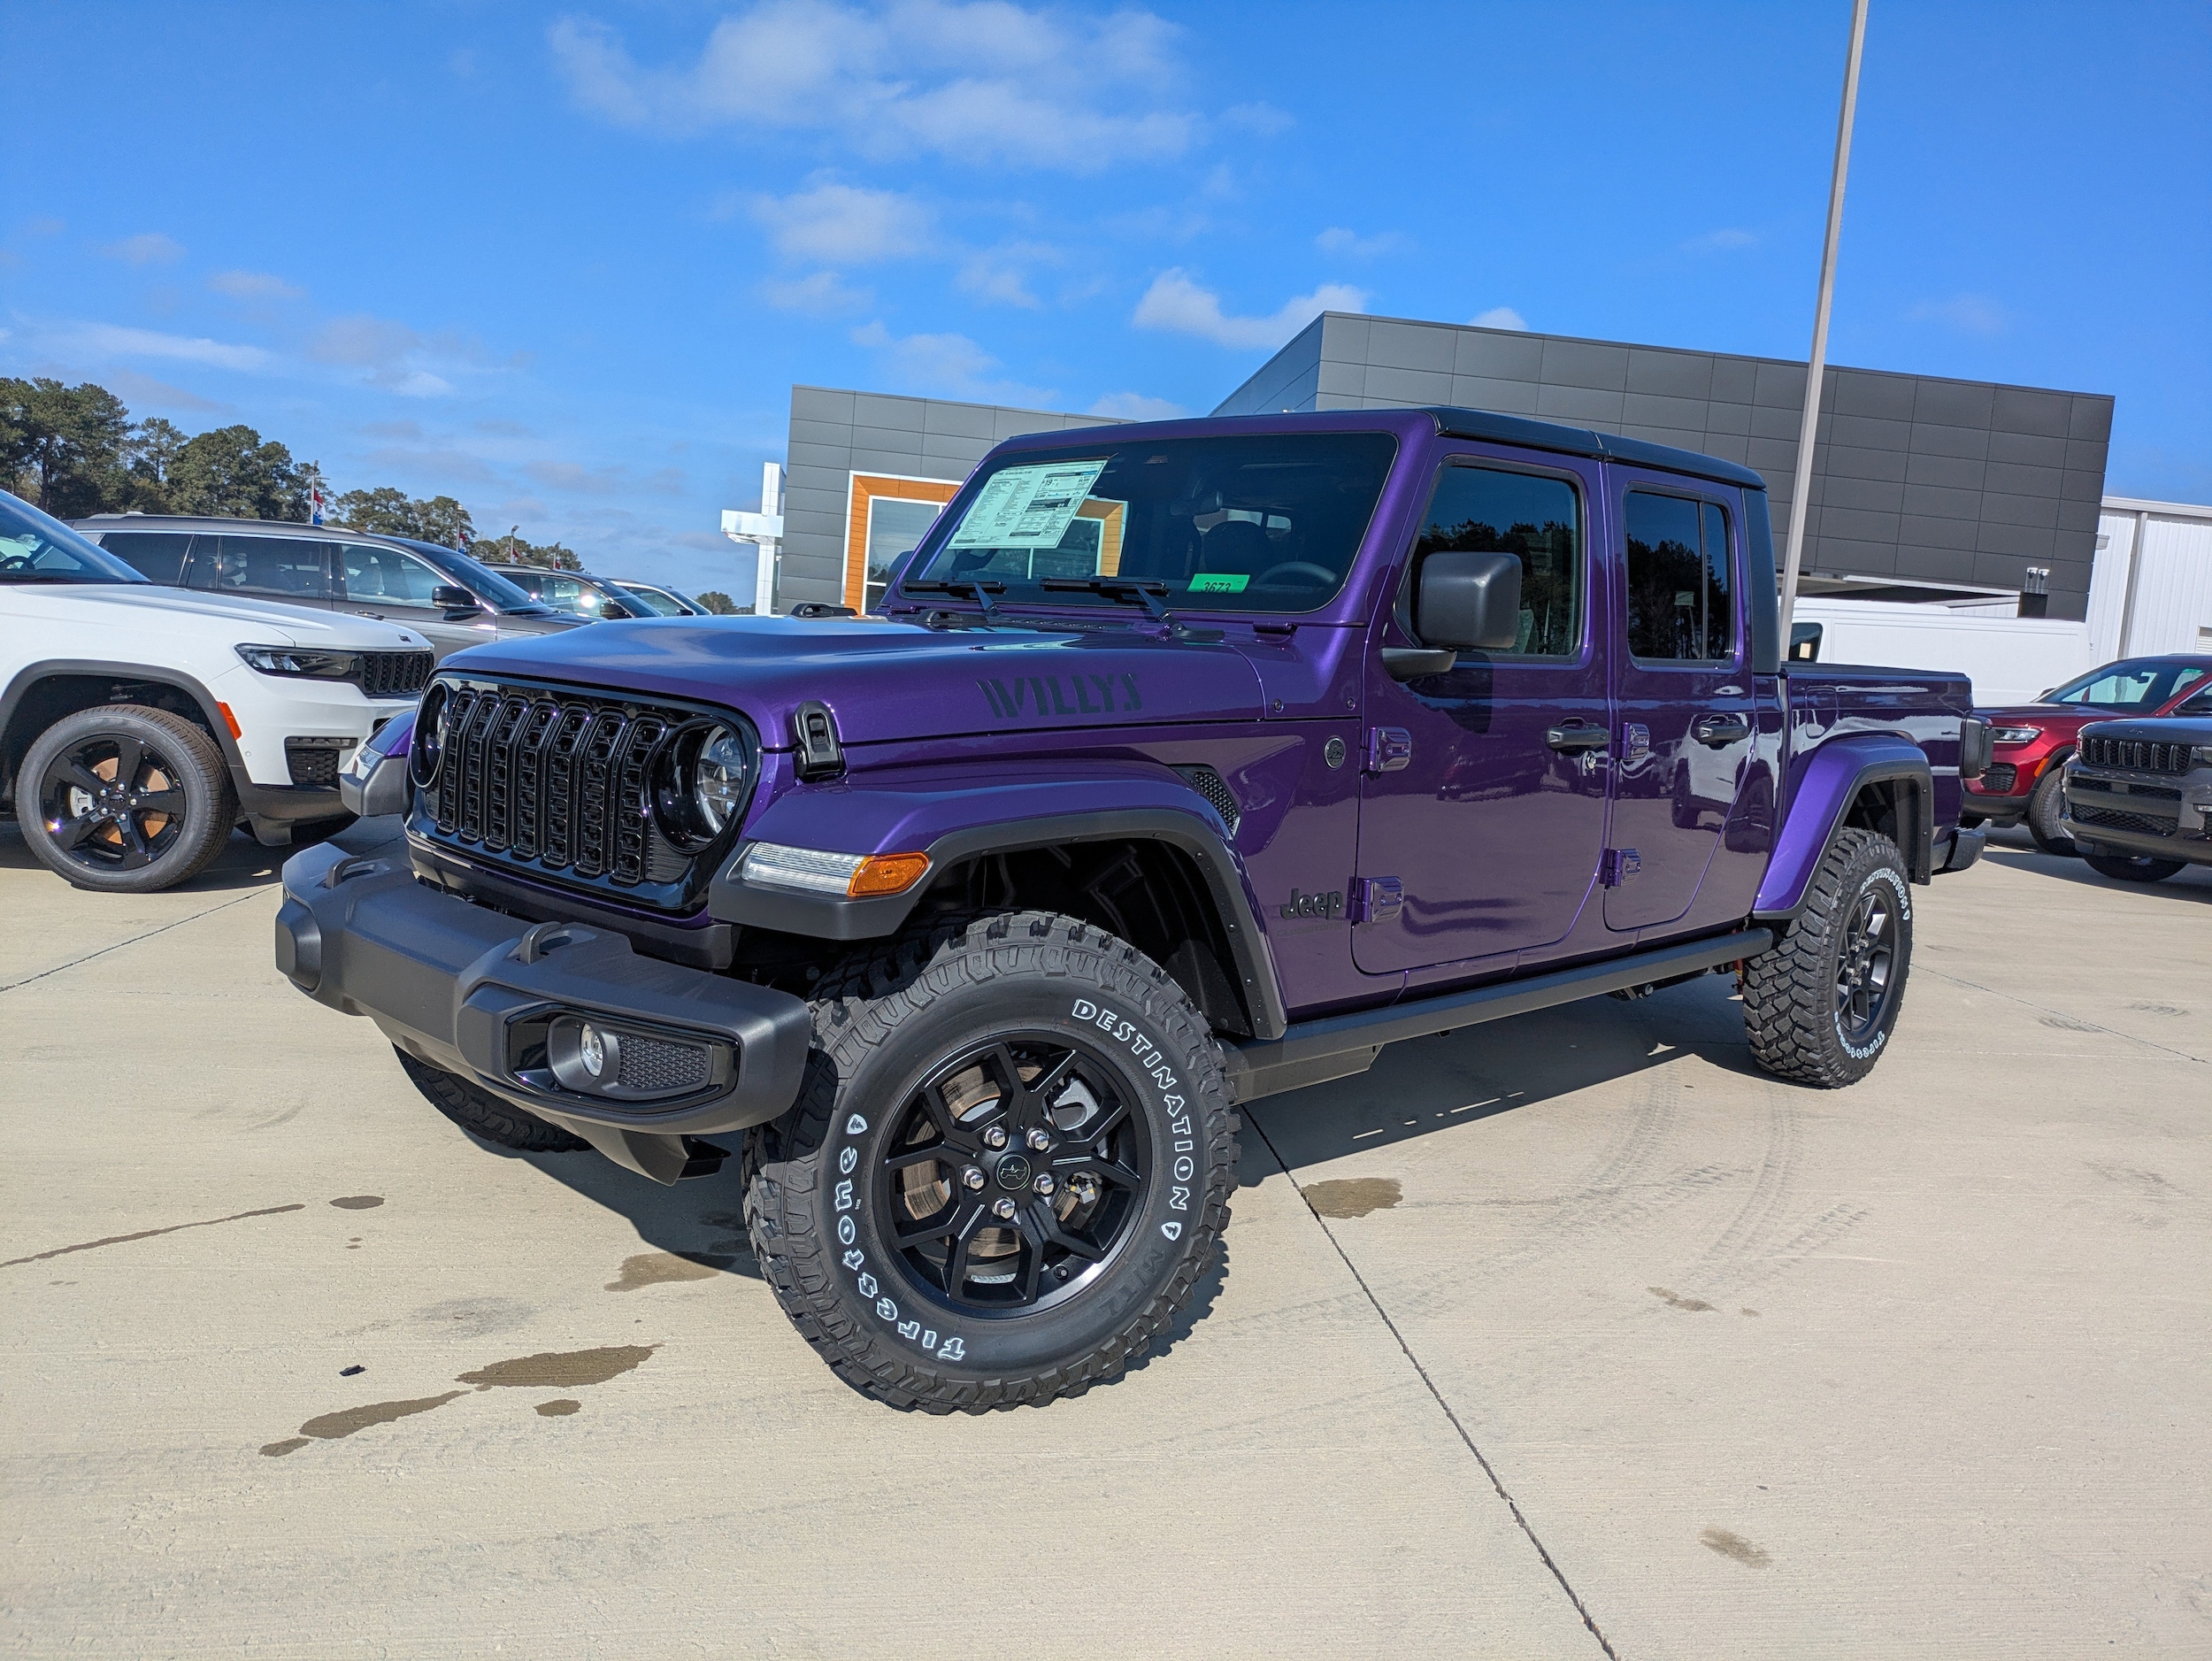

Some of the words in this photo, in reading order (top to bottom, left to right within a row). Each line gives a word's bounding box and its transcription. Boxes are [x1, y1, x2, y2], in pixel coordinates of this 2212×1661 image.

[1201, 581, 1232, 593] 3673
[977, 672, 1143, 719] WILLYS
[1279, 888, 1344, 920] Jeep
[1072, 997, 1194, 1212] DESTINATION
[833, 1144, 967, 1361] Firestone
